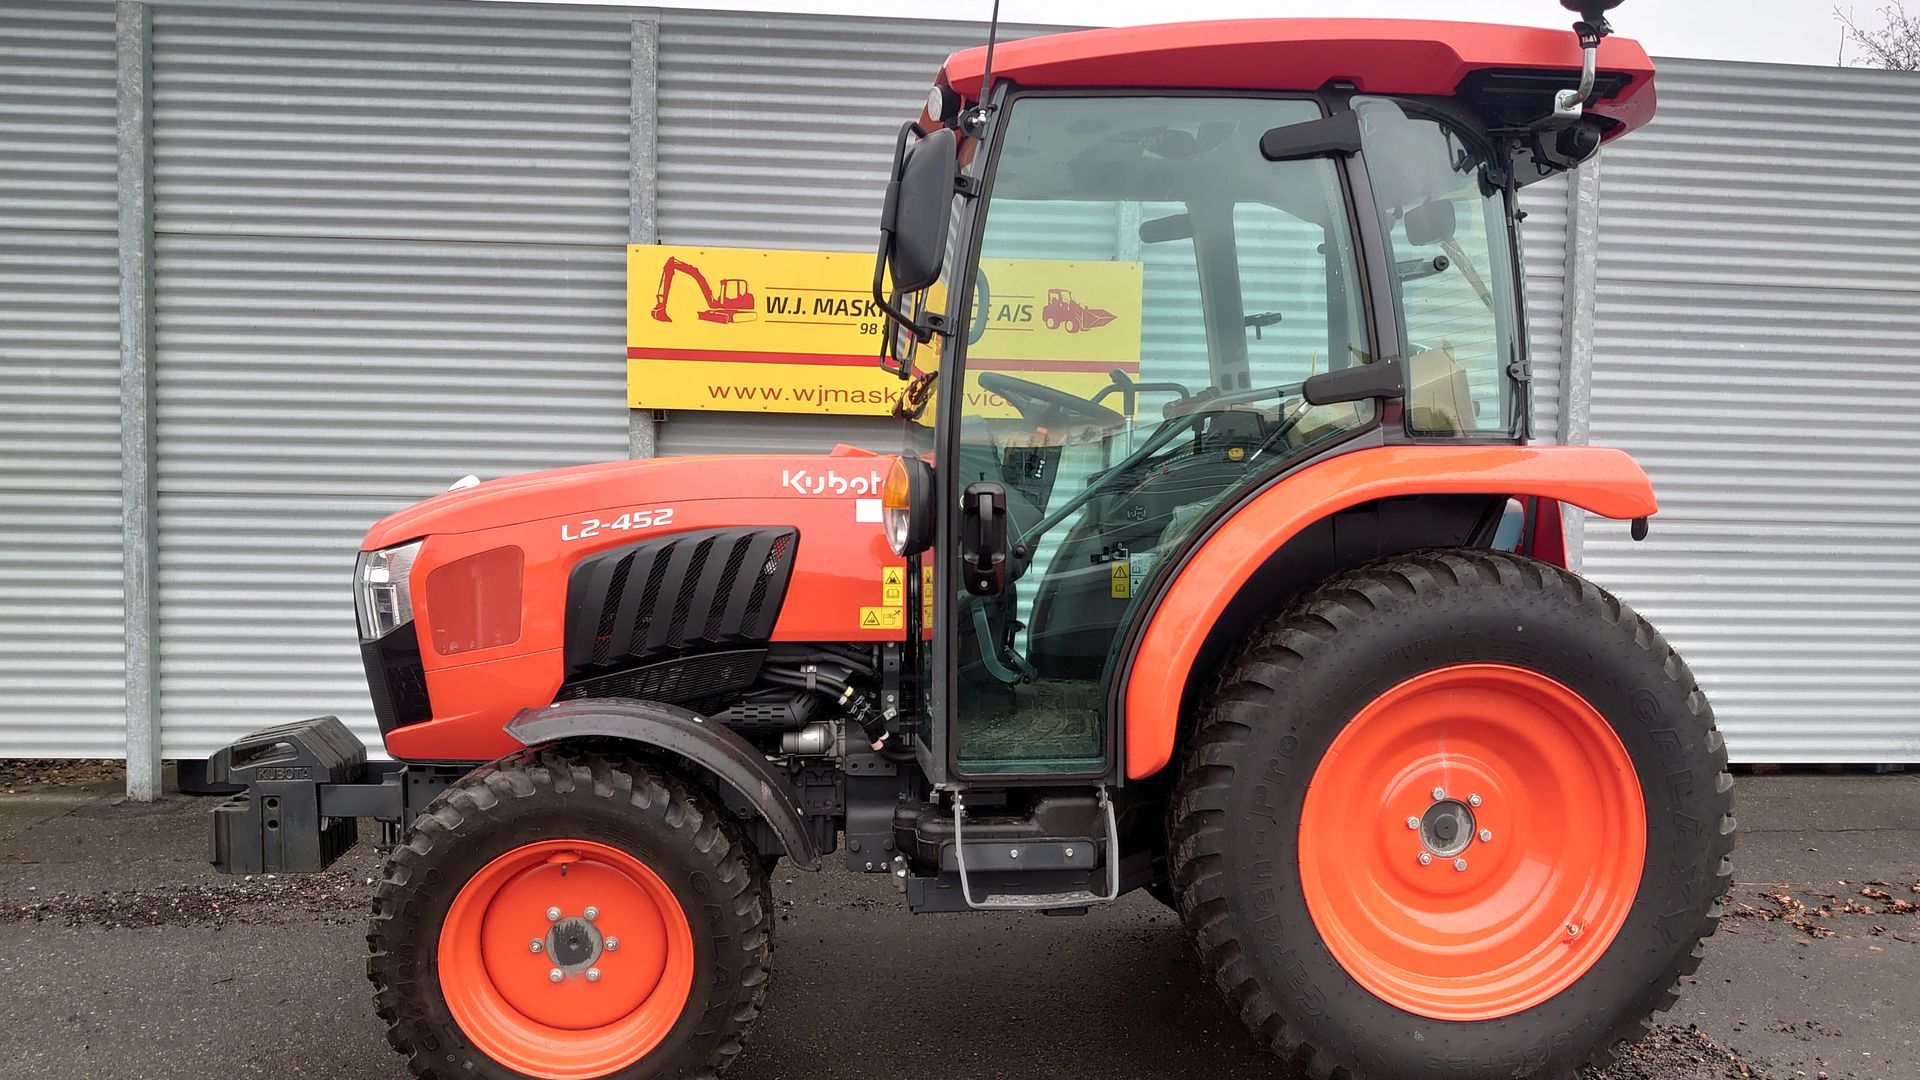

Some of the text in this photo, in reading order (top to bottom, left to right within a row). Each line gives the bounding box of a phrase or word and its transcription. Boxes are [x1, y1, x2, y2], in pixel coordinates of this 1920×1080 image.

[766, 296, 806, 315] W.J.
[996, 304, 1034, 323] A/S
[859, 322, 878, 335] 98
[782, 469, 886, 495] Kubot
[561, 508, 674, 541] L2-452
[256, 766, 312, 780] KUBOTA
